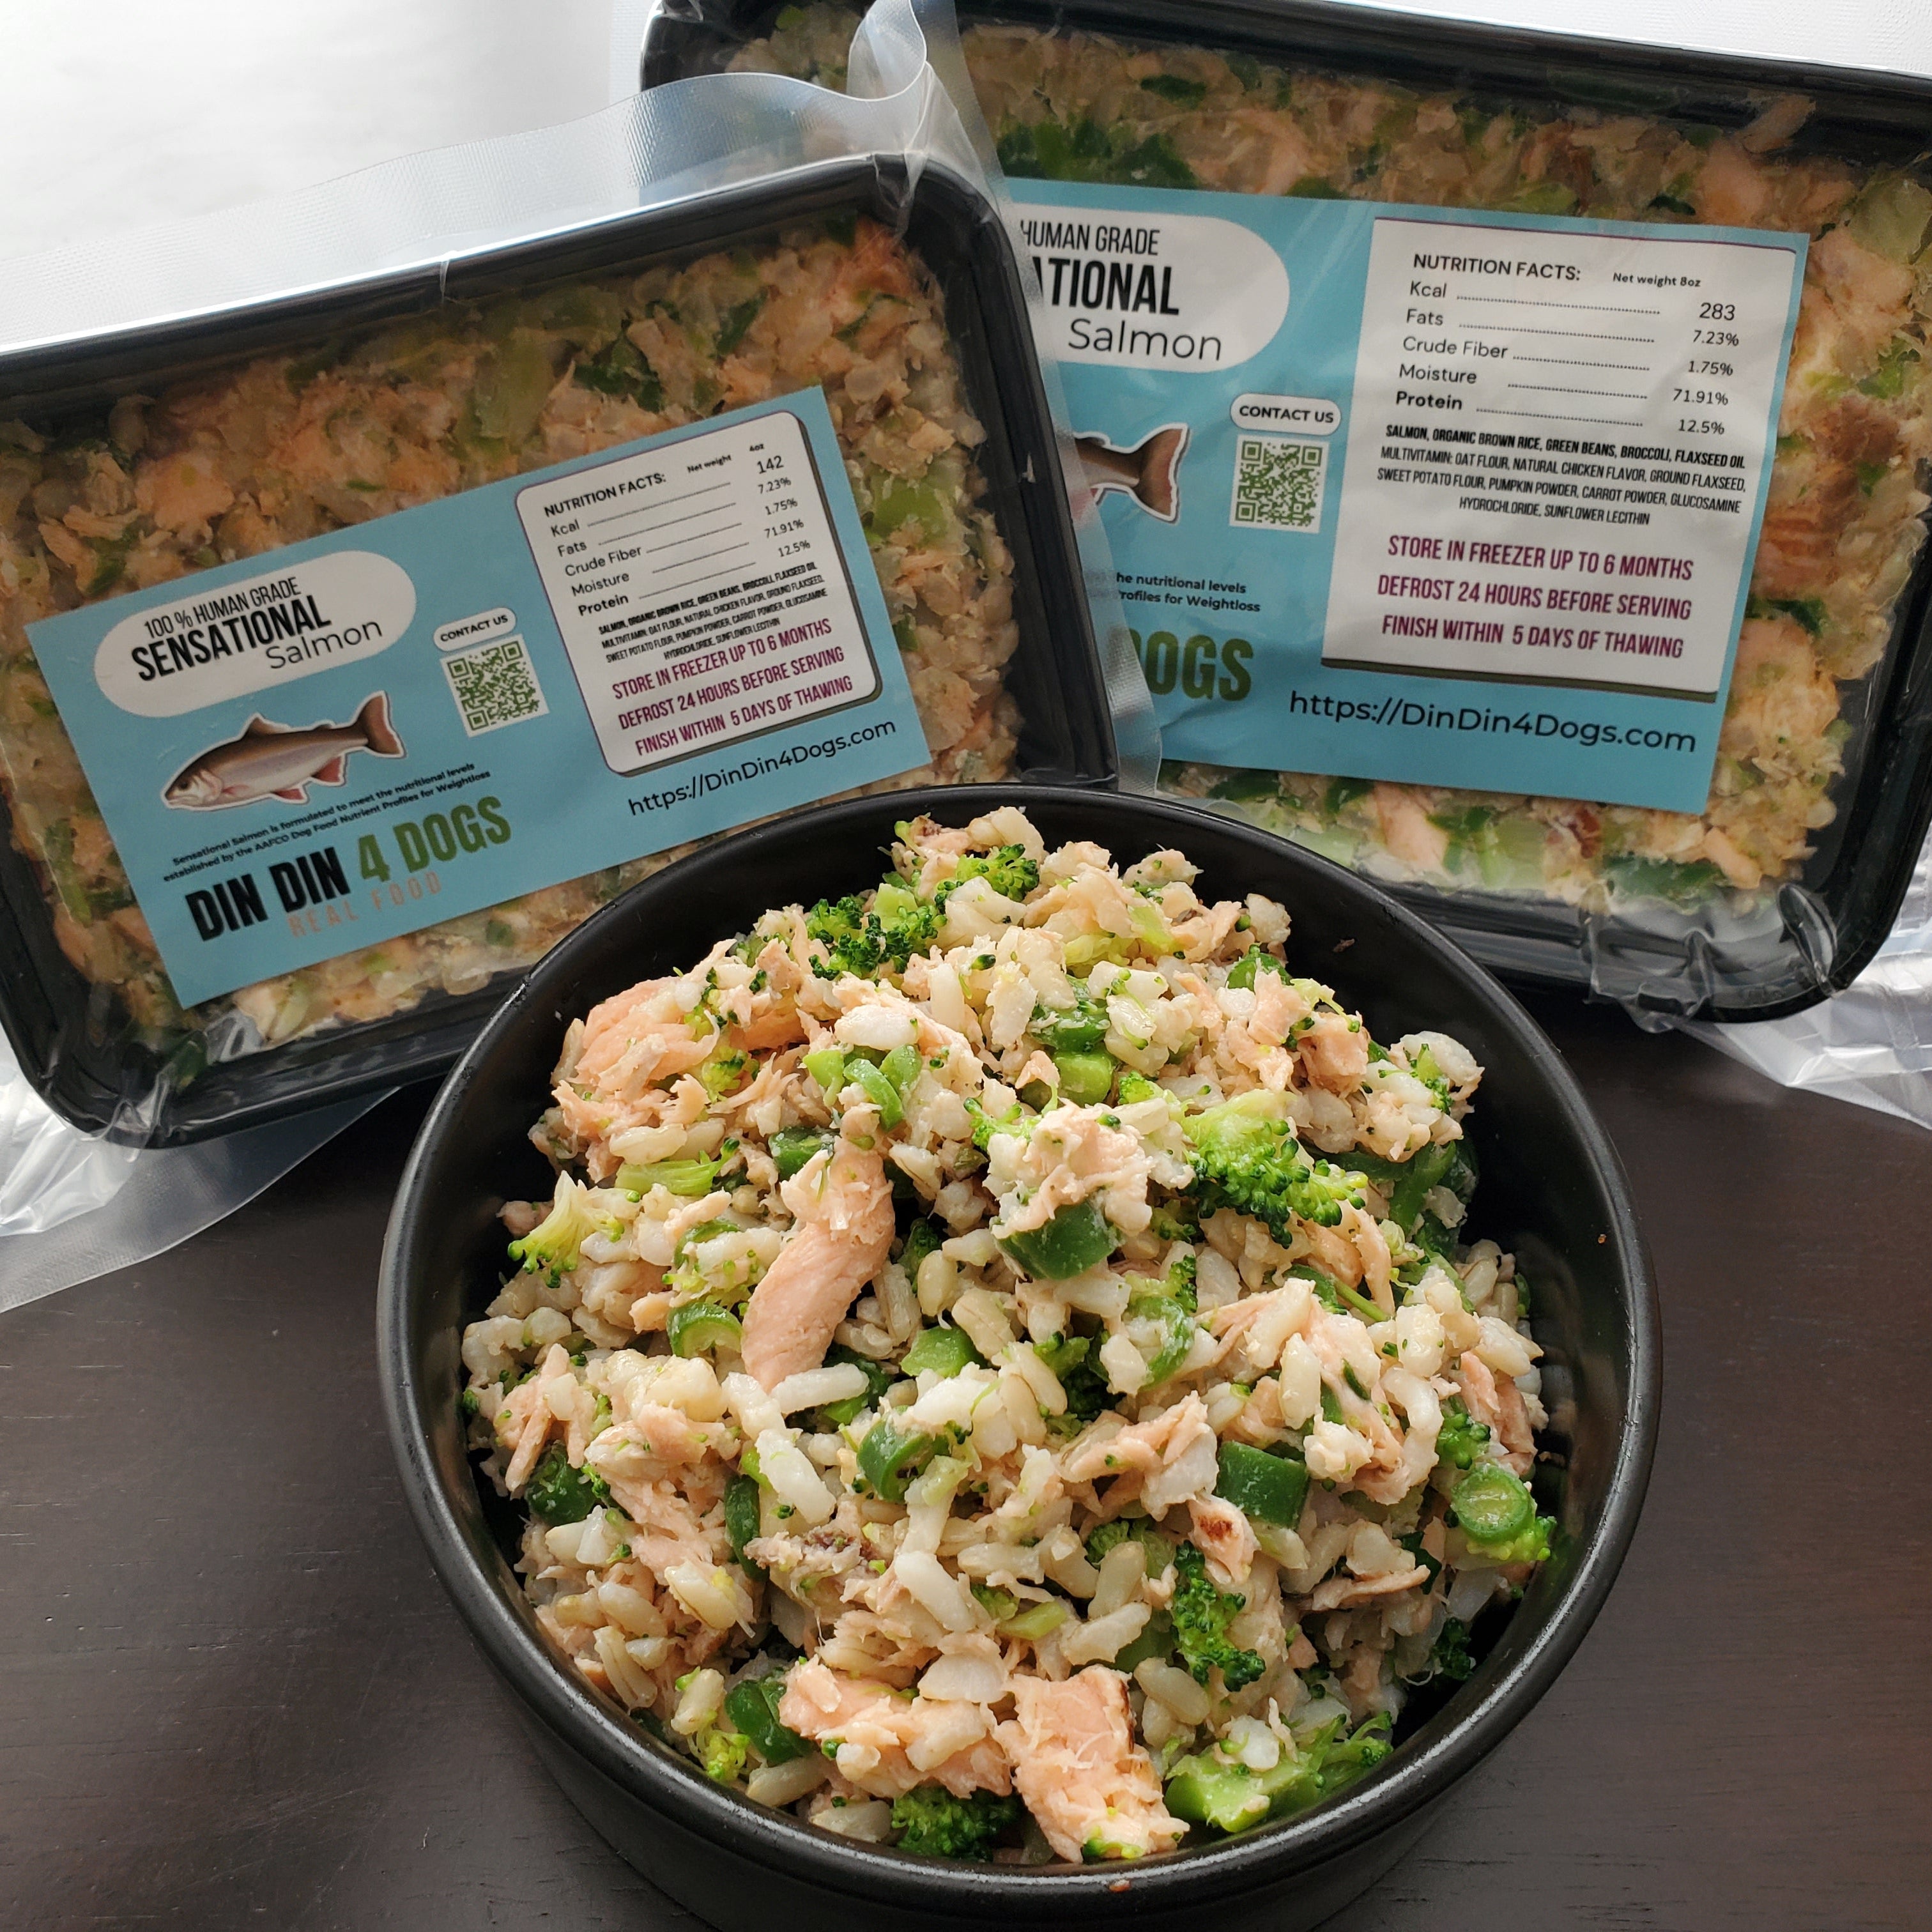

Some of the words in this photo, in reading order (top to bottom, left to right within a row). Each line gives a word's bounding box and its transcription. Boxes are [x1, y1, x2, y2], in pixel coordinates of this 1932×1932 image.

[1020, 220, 1090, 250] HUMAN
[1095, 225, 1160, 256] GRADE
[1413, 253, 1512, 275] NUTRITION
[1516, 261, 1581, 280] FACTS:
[1613, 272, 1634, 283] Net
[1637, 275, 1677, 288] weight
[1680, 276, 1701, 288] 8oz
[1409, 280, 1447, 298] Kcal
[1699, 302, 1735, 321] 283
[1068, 318, 1221, 360] Salmon
[1406, 308, 1443, 326] Fats
[1693, 330, 1739, 346] 7.23%
[1402, 335, 1457, 355] Crude
[1462, 341, 1508, 358] Fiber
[1688, 360, 1733, 376] 1.75%
[1399, 363, 1477, 384] Moisture
[1673, 388, 1728, 406] 71.91%
[1239, 405, 1310, 421] CONTACT
[1314, 411, 1333, 424] US
[1395, 390, 1462, 410] Protein
[1678, 418, 1724, 434] 12.5%
[1386, 424, 1429, 441] SALMON,
[1432, 428, 1476, 444] ORGANIC
[1478, 433, 1515, 448] BROWN
[1517, 436, 1542, 451] RICE,
[1545, 438, 1579, 453] GREEN
[1581, 441, 1617, 458] BEANS,
[1620, 445, 1672, 463] BROCCOLI,
[1675, 449, 1728, 467] FLAXSEED
[1729, 455, 1745, 469] OIL
[544, 486, 617, 517] NUTRITION
[618, 472, 666, 494] FACTS:
[1377, 467, 1412, 482] SWEET
[1413, 470, 1452, 486] POTATO
[1488, 477, 1533, 493] PUMPKIN
[1581, 485, 1623, 502] CARROT
[1670, 493, 1741, 513] GLUCOSAMINE
[1455, 452, 1476, 466] OAT
[1476, 454, 1510, 470] FLOUR,
[1512, 457, 1558, 474] NATURAL
[1561, 461, 1604, 478] CHICKEN
[1650, 470, 1690, 485] GROUND
[1691, 473, 1745, 492] FLAXSEED,
[550, 519, 579, 537] Kcal
[756, 455, 784, 474] 142
[557, 542, 587, 557] Fats
[758, 477, 792, 494] 7.23%
[1544, 504, 1605, 521] SUNFLOWER
[1606, 510, 1650, 525] LECITHIN
[565, 556, 606, 576] Crude
[608, 547, 641, 564] Fiber
[765, 498, 798, 515] 1.75%
[571, 572, 629, 597] Moisture
[764, 518, 804, 538] 71.91%
[1388, 535, 1443, 560] STORE
[1446, 540, 1466, 561] IN
[1469, 542, 1545, 568] FREEZER
[1549, 548, 1574, 571] UP
[1579, 551, 1599, 573] TO
[1603, 554, 1616, 574] 6
[1618, 555, 1694, 580] MONTHS
[578, 594, 629, 616] Protein
[778, 539, 811, 557] 12.5%
[1116, 572, 1133, 583] he
[1135, 575, 1205, 590] nutritional
[1208, 579, 1246, 594] levels
[1377, 574, 1455, 601] DEFROST
[1457, 581, 1480, 602] 24
[1484, 583, 1543, 608] HOURS
[1546, 588, 1614, 613] BEFORE
[1616, 594, 1692, 620] SERVING
[144, 615, 174, 638] 100
[173, 610, 194, 629] %
[192, 592, 250, 624] HUMAN
[249, 576, 301, 607] GRADE
[1118, 589, 1161, 602] rofiles
[1164, 592, 1183, 604] for
[1186, 595, 1261, 612] Weightloss
[131, 594, 332, 681] SENSATIONAL
[265, 621, 382, 669] Salmon
[440, 620, 490, 642] CONTACT
[493, 614, 508, 625] US
[1381, 615, 1438, 638] FINISH
[1443, 619, 1504, 643] WITHIN
[1512, 625, 1524, 645] 5
[1527, 626, 1574, 648] DAYS
[1577, 629, 1600, 650] OF
[1604, 631, 1683, 658] THAWING
[612, 673, 656, 700] STORE
[655, 668, 671, 686] IN
[671, 650, 728, 681] FREEZER
[728, 643, 746, 663] UP
[747, 638, 766, 656] TO
[766, 634, 777, 650] 6
[778, 618, 832, 648] MONTHS
[618, 698, 675, 730] DEFROST
[677, 692, 696, 711] 24
[696, 678, 740, 705] HOURS
[740, 662, 790, 691] BEFORE
[790, 645, 844, 675] SERVING
[634, 728, 678, 756] FINISH
[678, 714, 726, 741] WITHIN
[730, 710, 740, 726] 5
[740, 699, 776, 723] DAYS
[776, 693, 792, 711] OF
[793, 675, 853, 705] THAWING
[1289, 689, 1696, 752] https://DinDin4Dogs.com
[628, 721, 896, 816] https://DinDin4Dogs.com
[185, 873, 268, 941] DIN
[268, 846, 351, 913] DIN
[357, 834, 391, 882] 4
[392, 795, 511, 873] DOGS
[286, 899, 358, 938] REAL
[370, 870, 441, 910] FOOD
